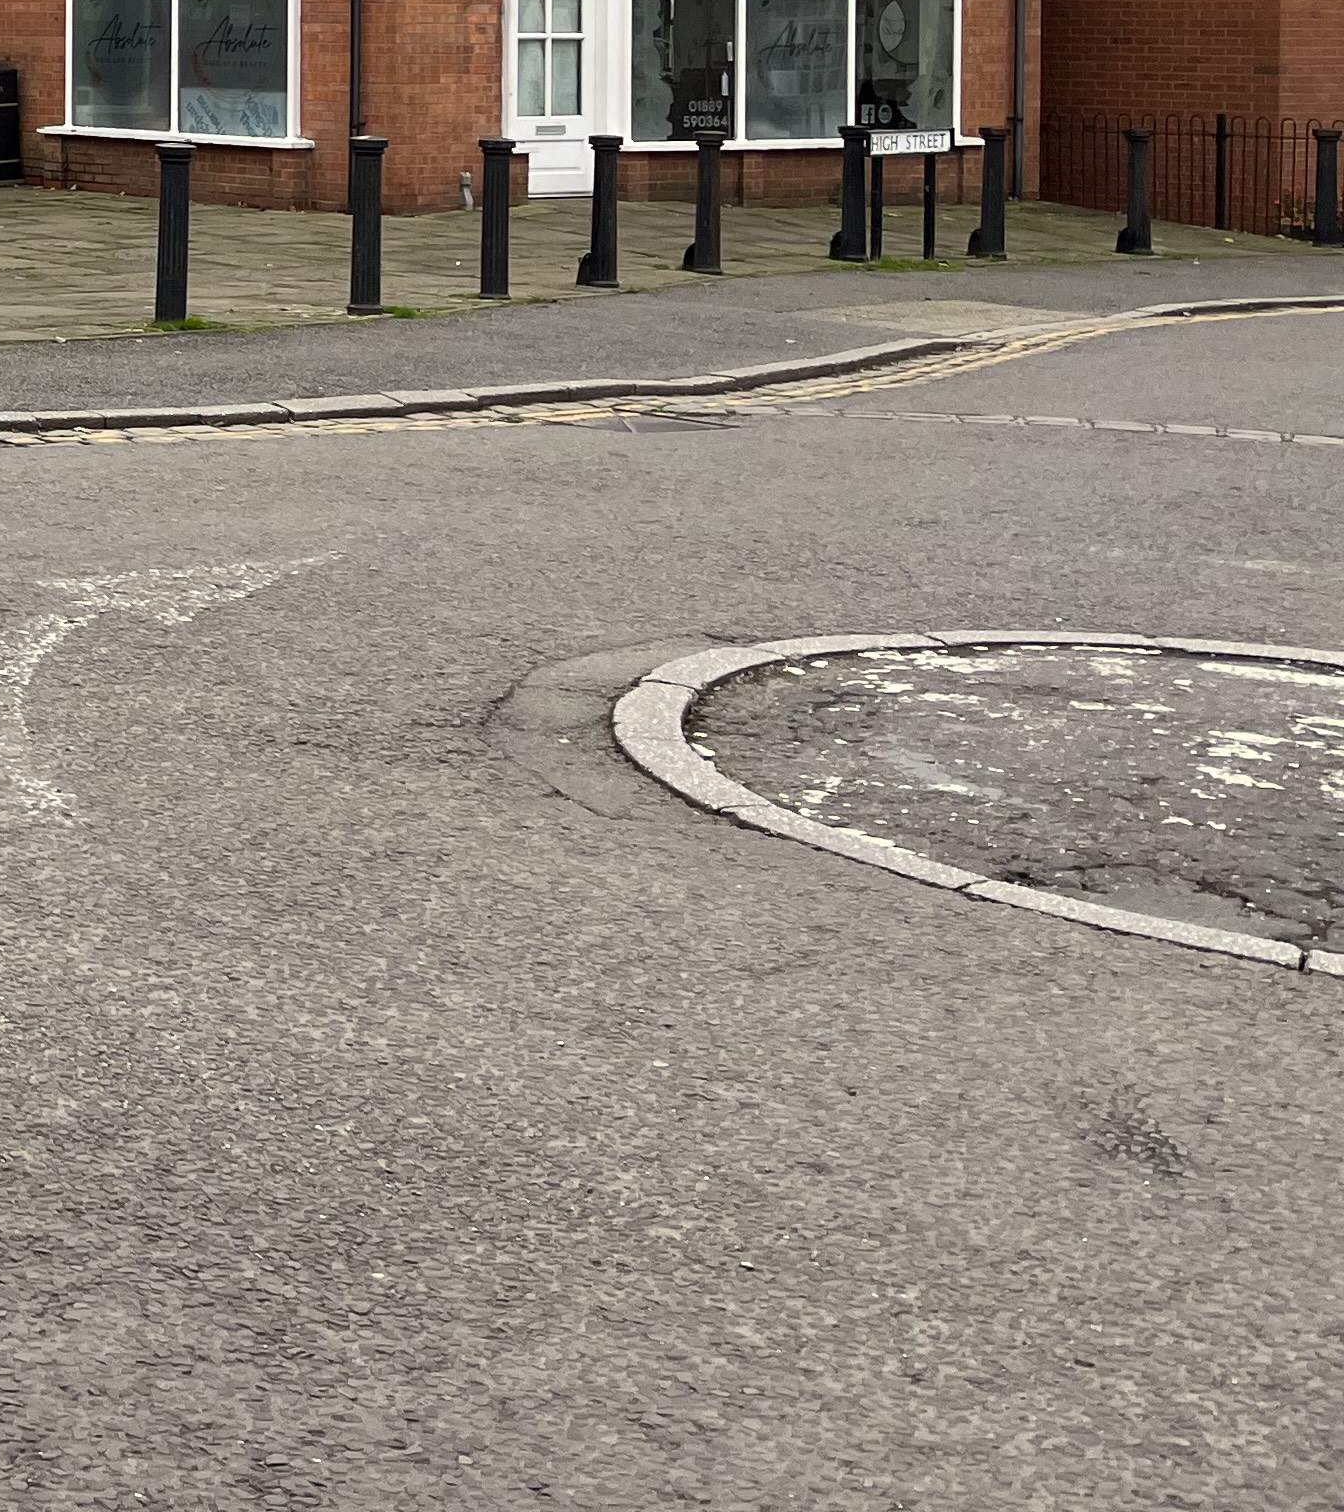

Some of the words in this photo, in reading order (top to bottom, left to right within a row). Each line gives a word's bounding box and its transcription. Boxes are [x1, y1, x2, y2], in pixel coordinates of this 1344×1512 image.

[88, 13, 160, 57] Absolute
[196, 15, 277, 58] Absolute
[760, 19, 838, 64] Absolute
[683, 115, 728, 128] 590364
[688, 100, 723, 113] 01889
[872, 135, 899, 151] HIGH
[906, 133, 946, 150] STREET
